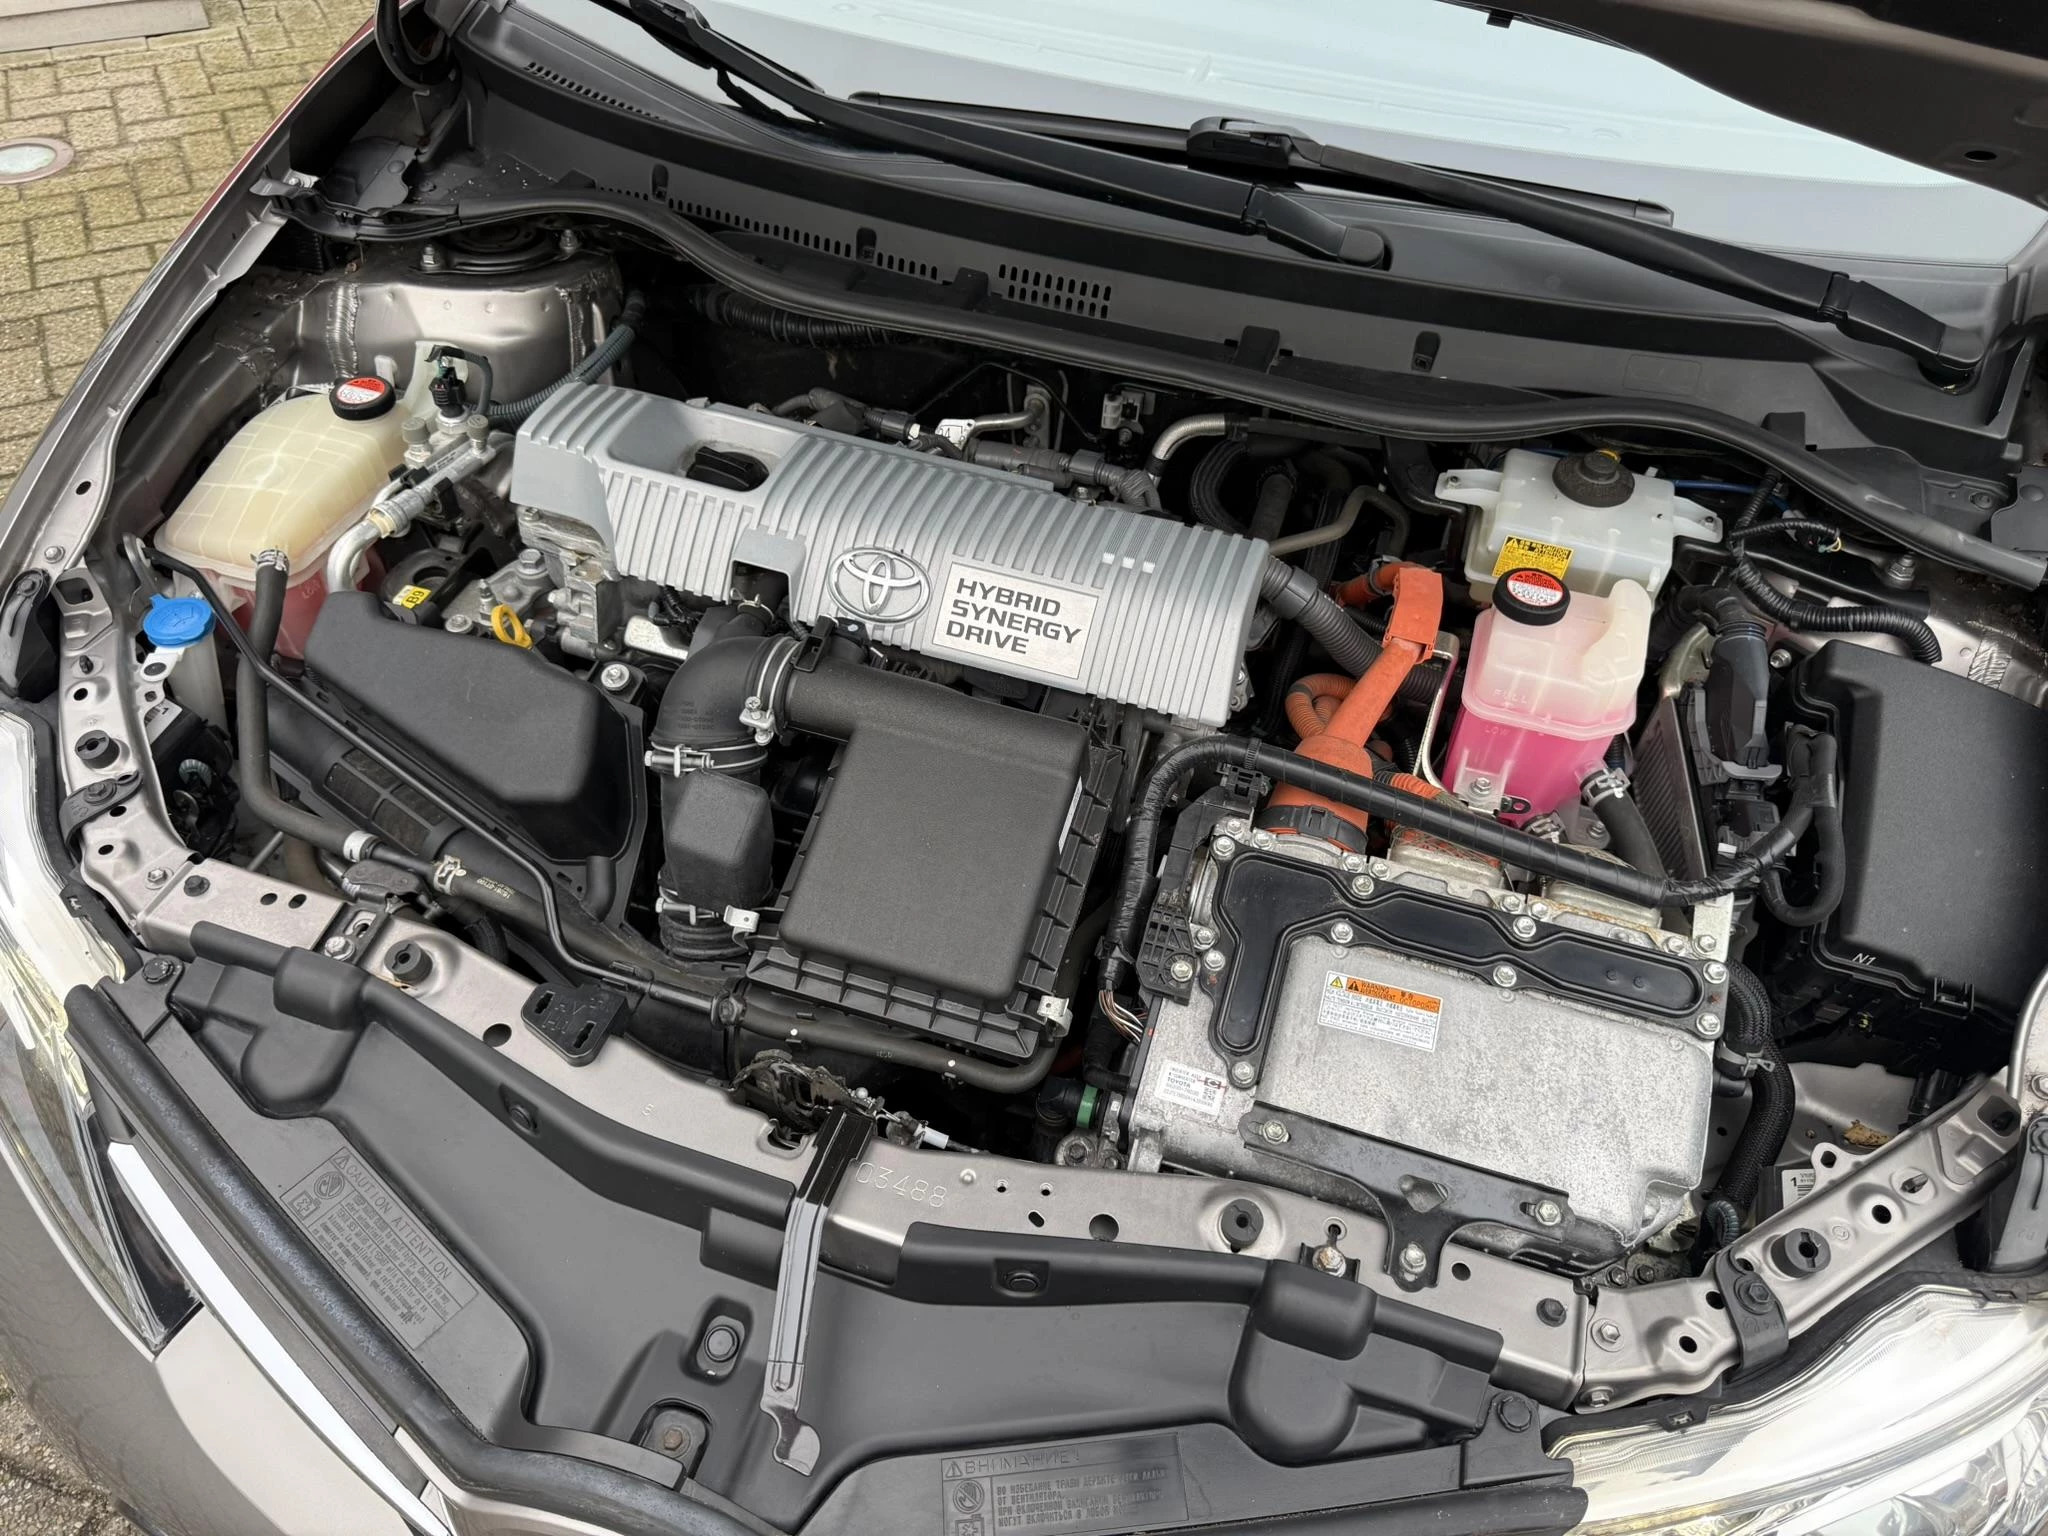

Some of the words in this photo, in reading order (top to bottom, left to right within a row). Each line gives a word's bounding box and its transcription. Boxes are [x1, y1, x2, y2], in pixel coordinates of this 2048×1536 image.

[407, 590, 425, 604] B9
[956, 577, 1061, 617] HYBRID
[951, 599, 1082, 643] SYNERGY
[946, 620, 1029, 654] DRIVE
[1852, 952, 1877, 966] N1
[1167, 1077, 1191, 1089] TOYOTA
[855, 1162, 947, 1208] 03488
[1790, 1177, 1798, 1188] 1
[346, 1164, 394, 1214] CAUTION
[392, 1216, 452, 1280] ATTENTION
[965, 1449, 1080, 1475] ВНИМАНИЕ!
